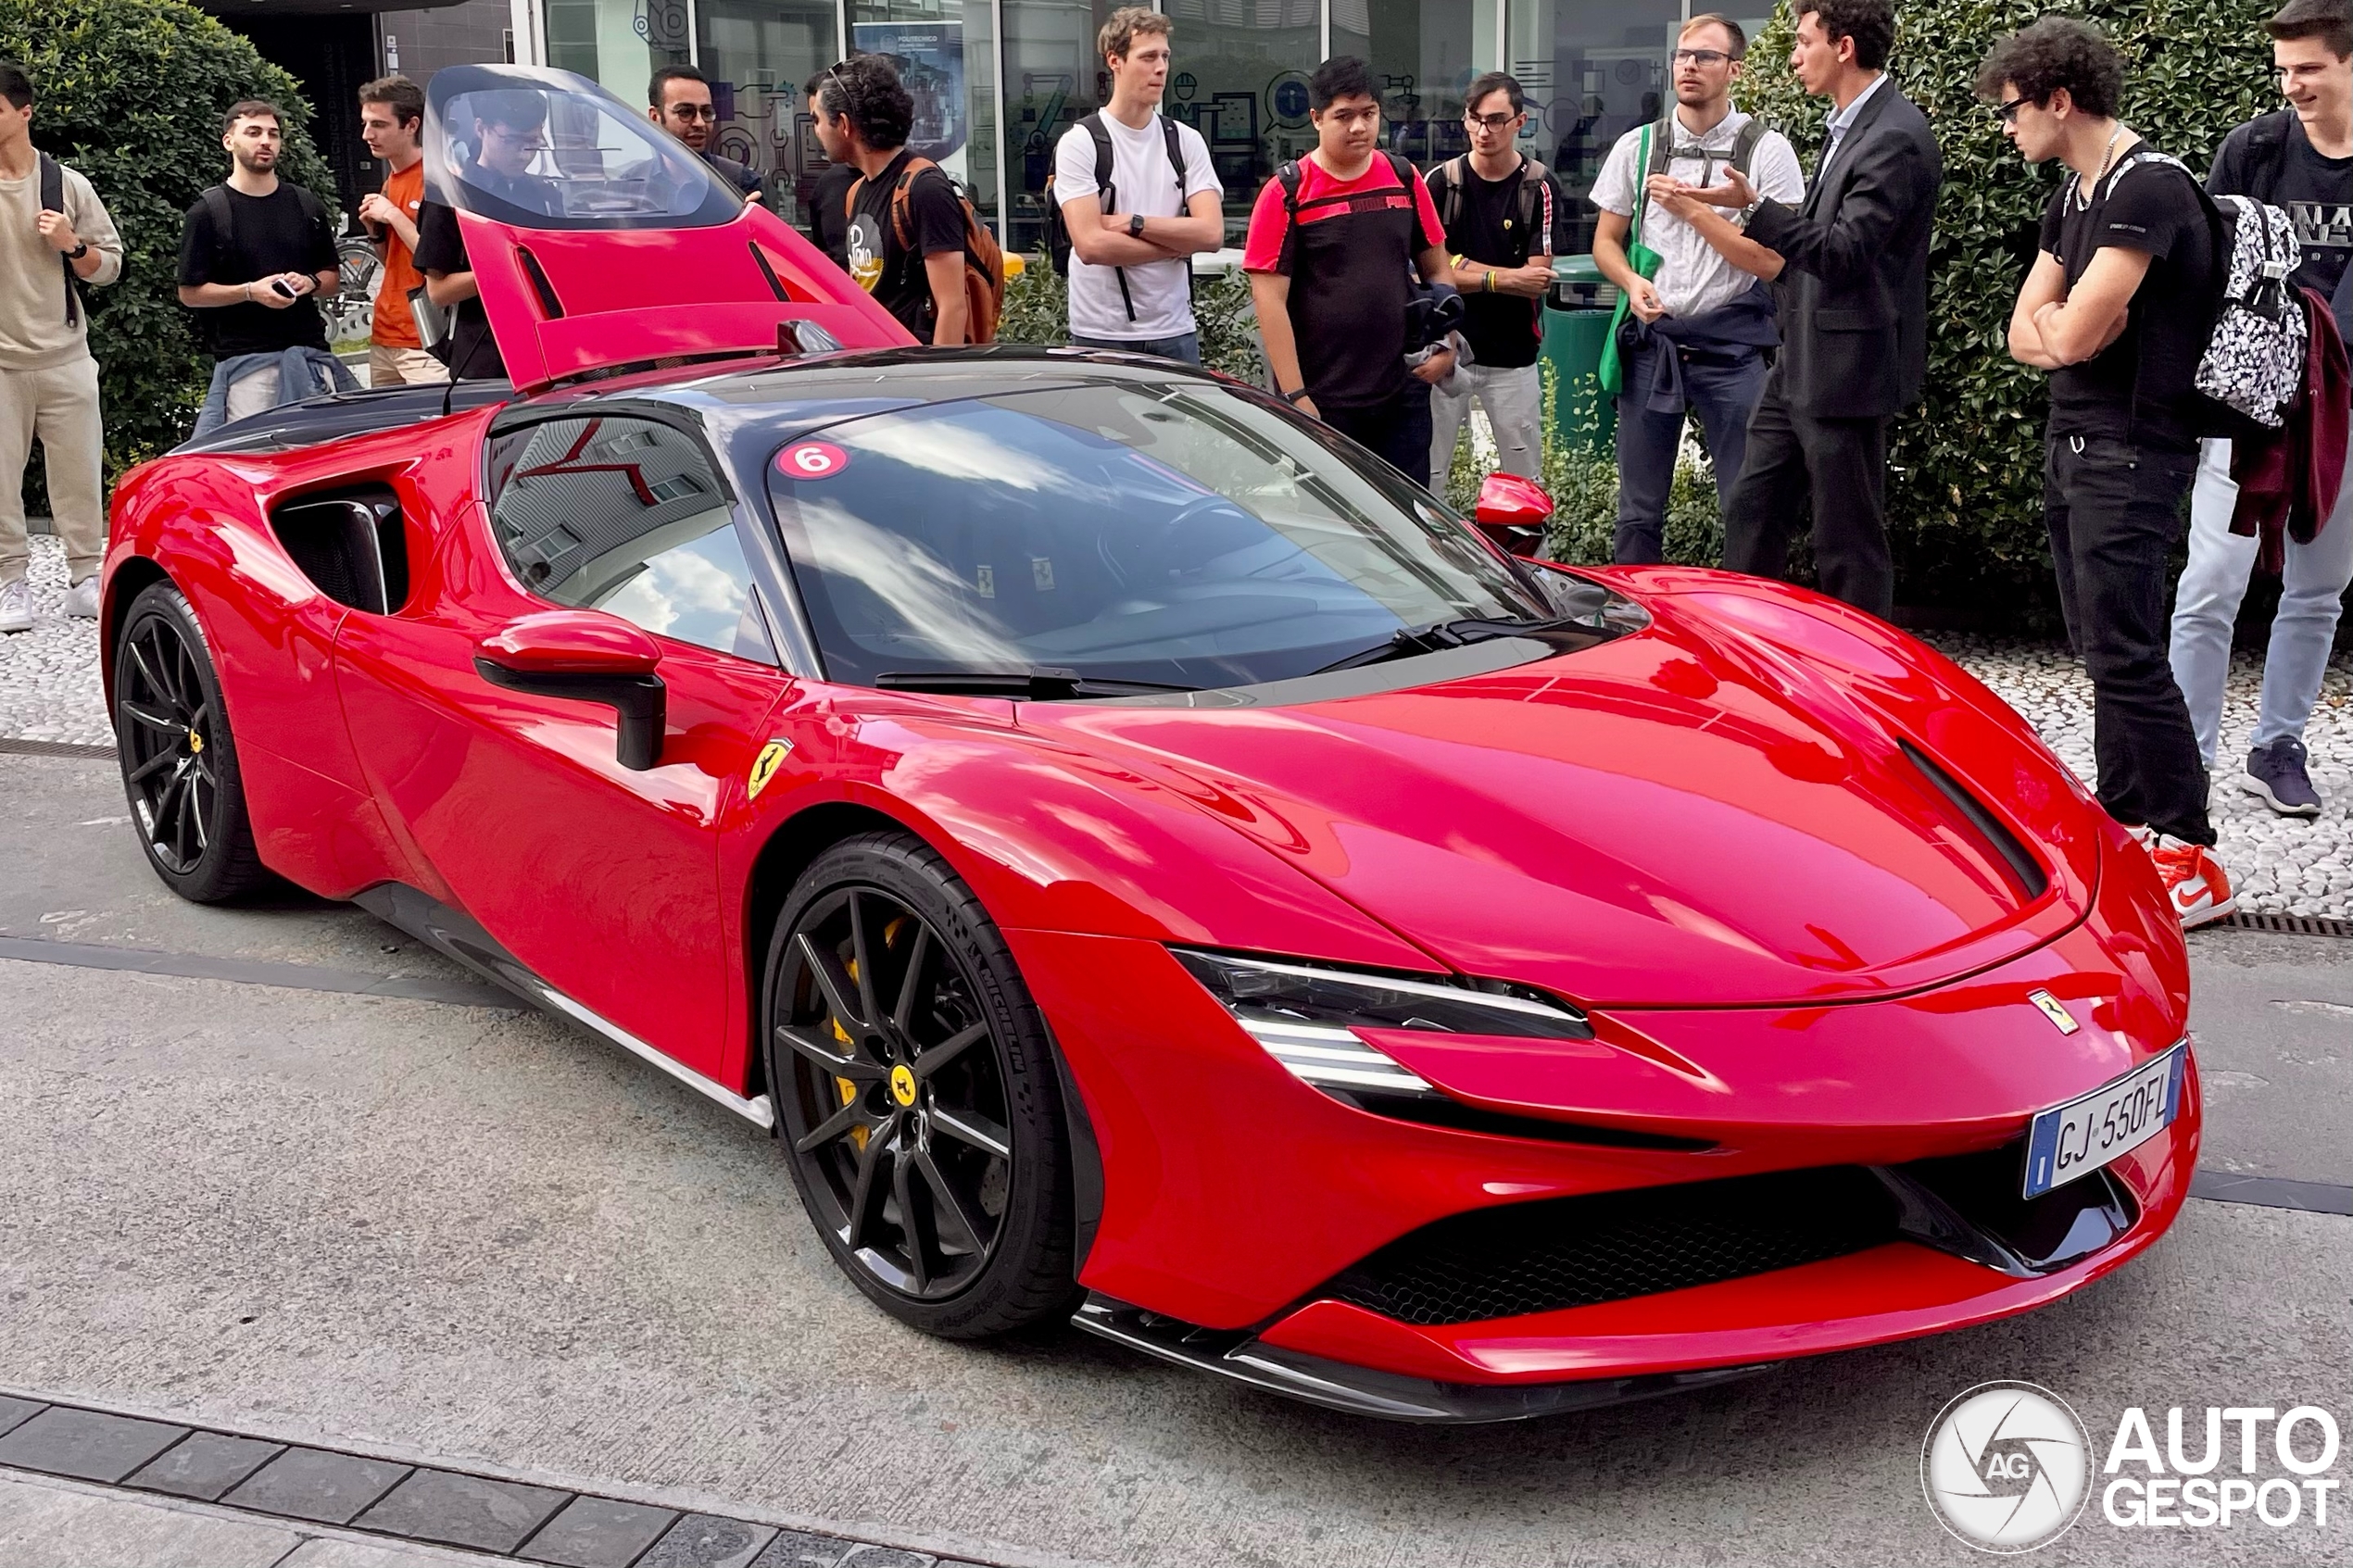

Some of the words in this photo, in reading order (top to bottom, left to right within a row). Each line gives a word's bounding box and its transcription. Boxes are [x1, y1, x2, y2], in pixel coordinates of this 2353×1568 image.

[794, 446, 832, 472] 6
[980, 967, 1026, 1071] MICHELIN
[2057, 1112, 2094, 1170] GJ
[2101, 1073, 2166, 1149] 550FL
